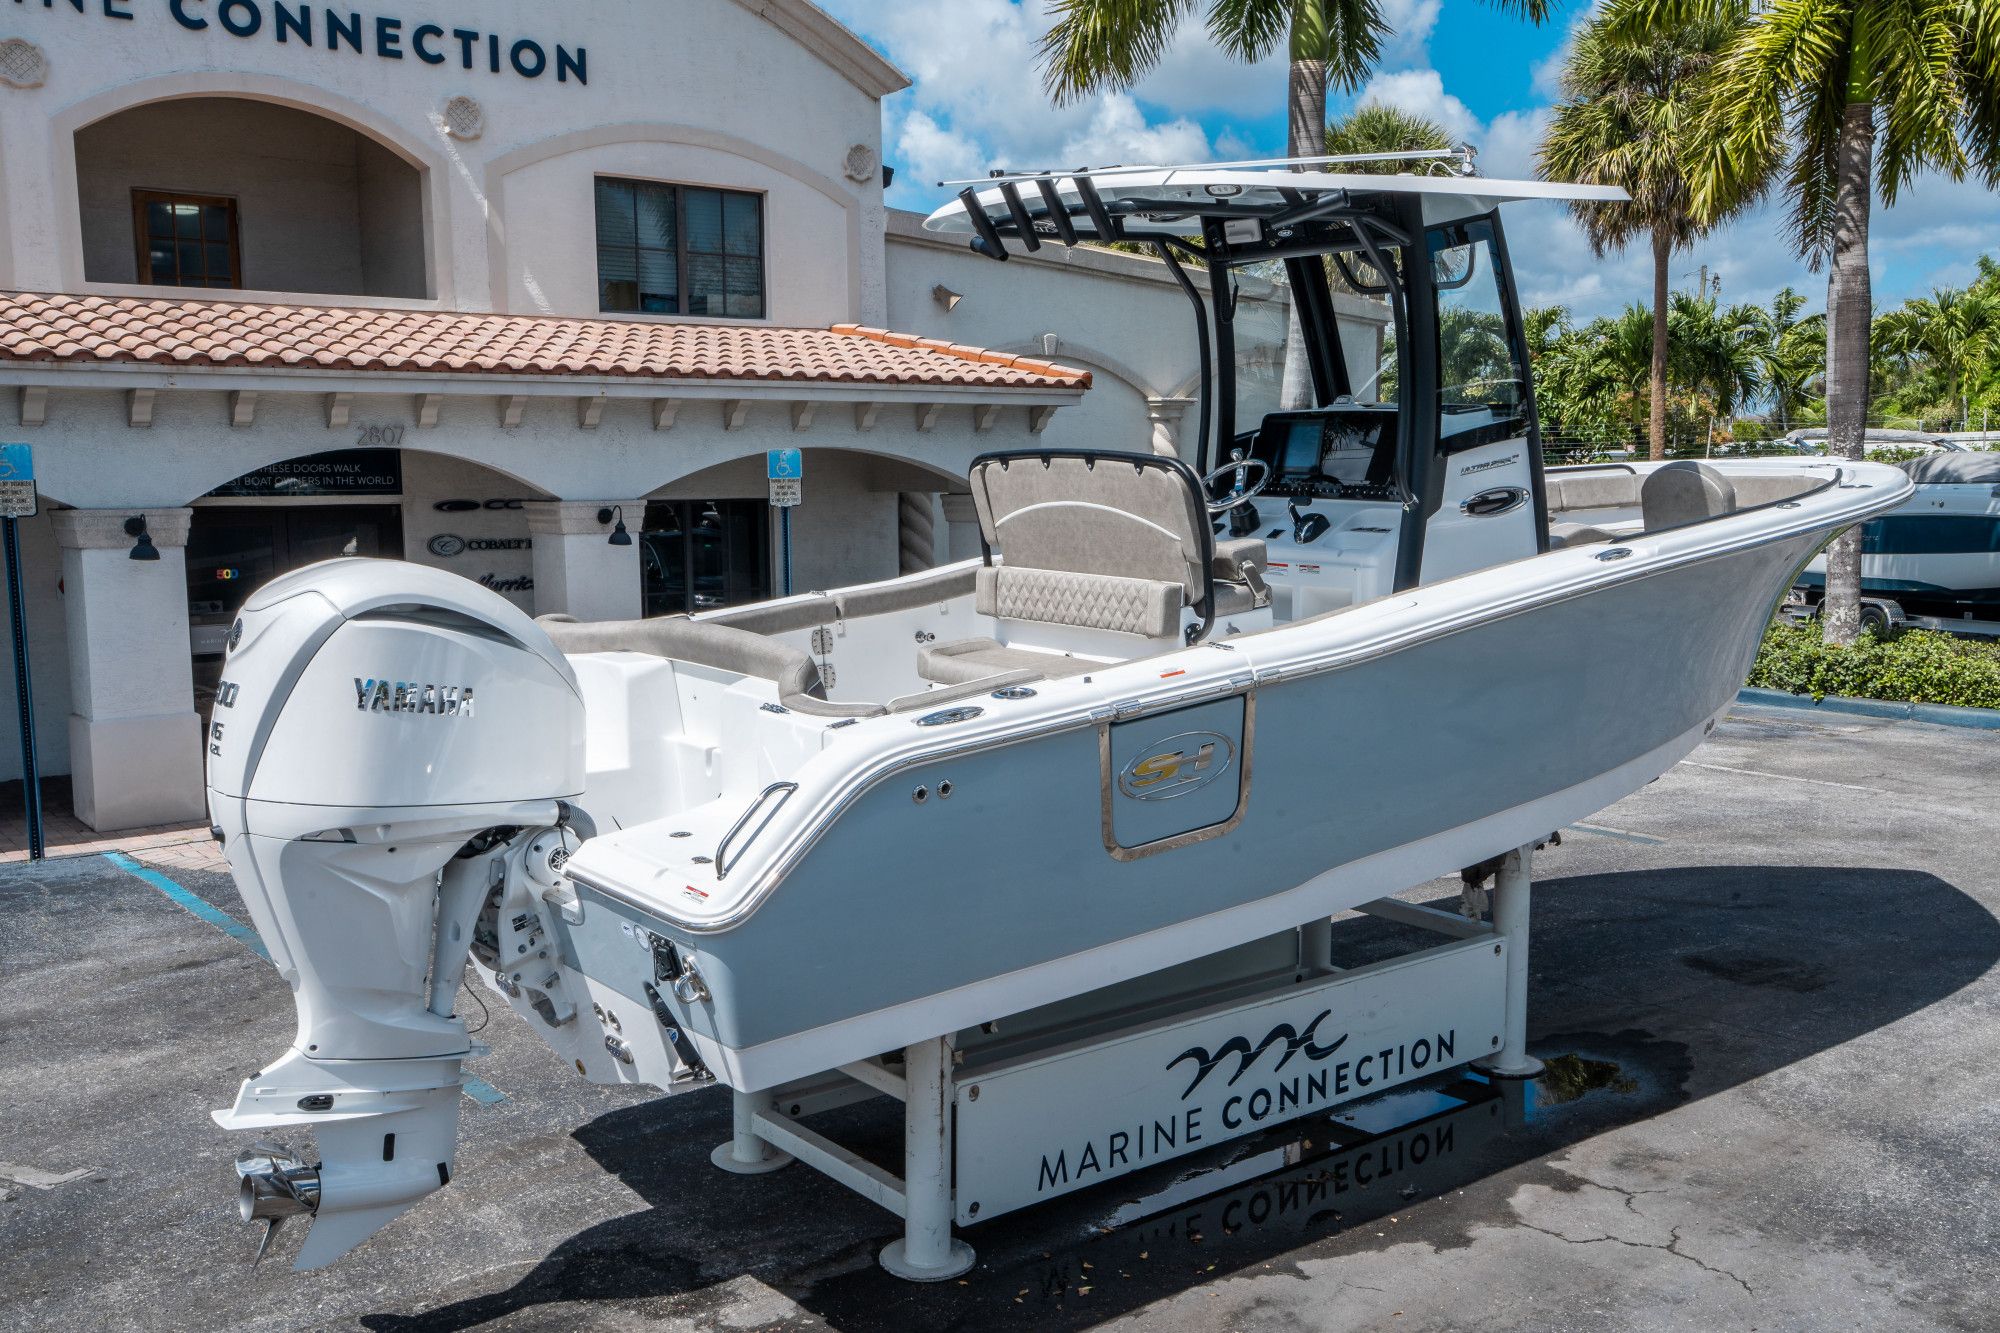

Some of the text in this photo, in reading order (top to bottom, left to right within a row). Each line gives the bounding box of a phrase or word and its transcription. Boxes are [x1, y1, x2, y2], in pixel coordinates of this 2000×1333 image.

[170, 0, 588, 86] CONNECTION
[357, 425, 405, 445] 2807
[293, 464, 332, 473] DOORS
[334, 464, 361, 473] WALK
[244, 477, 272, 486] BOAT
[323, 477, 334, 485] IN
[336, 477, 355, 485] THE
[357, 476, 395, 485] WORLD
[468, 539, 524, 551] COBALT
[353, 677, 475, 718] YAMAHA
[1038, 1029, 1455, 1192] MARINE CONNECTION
